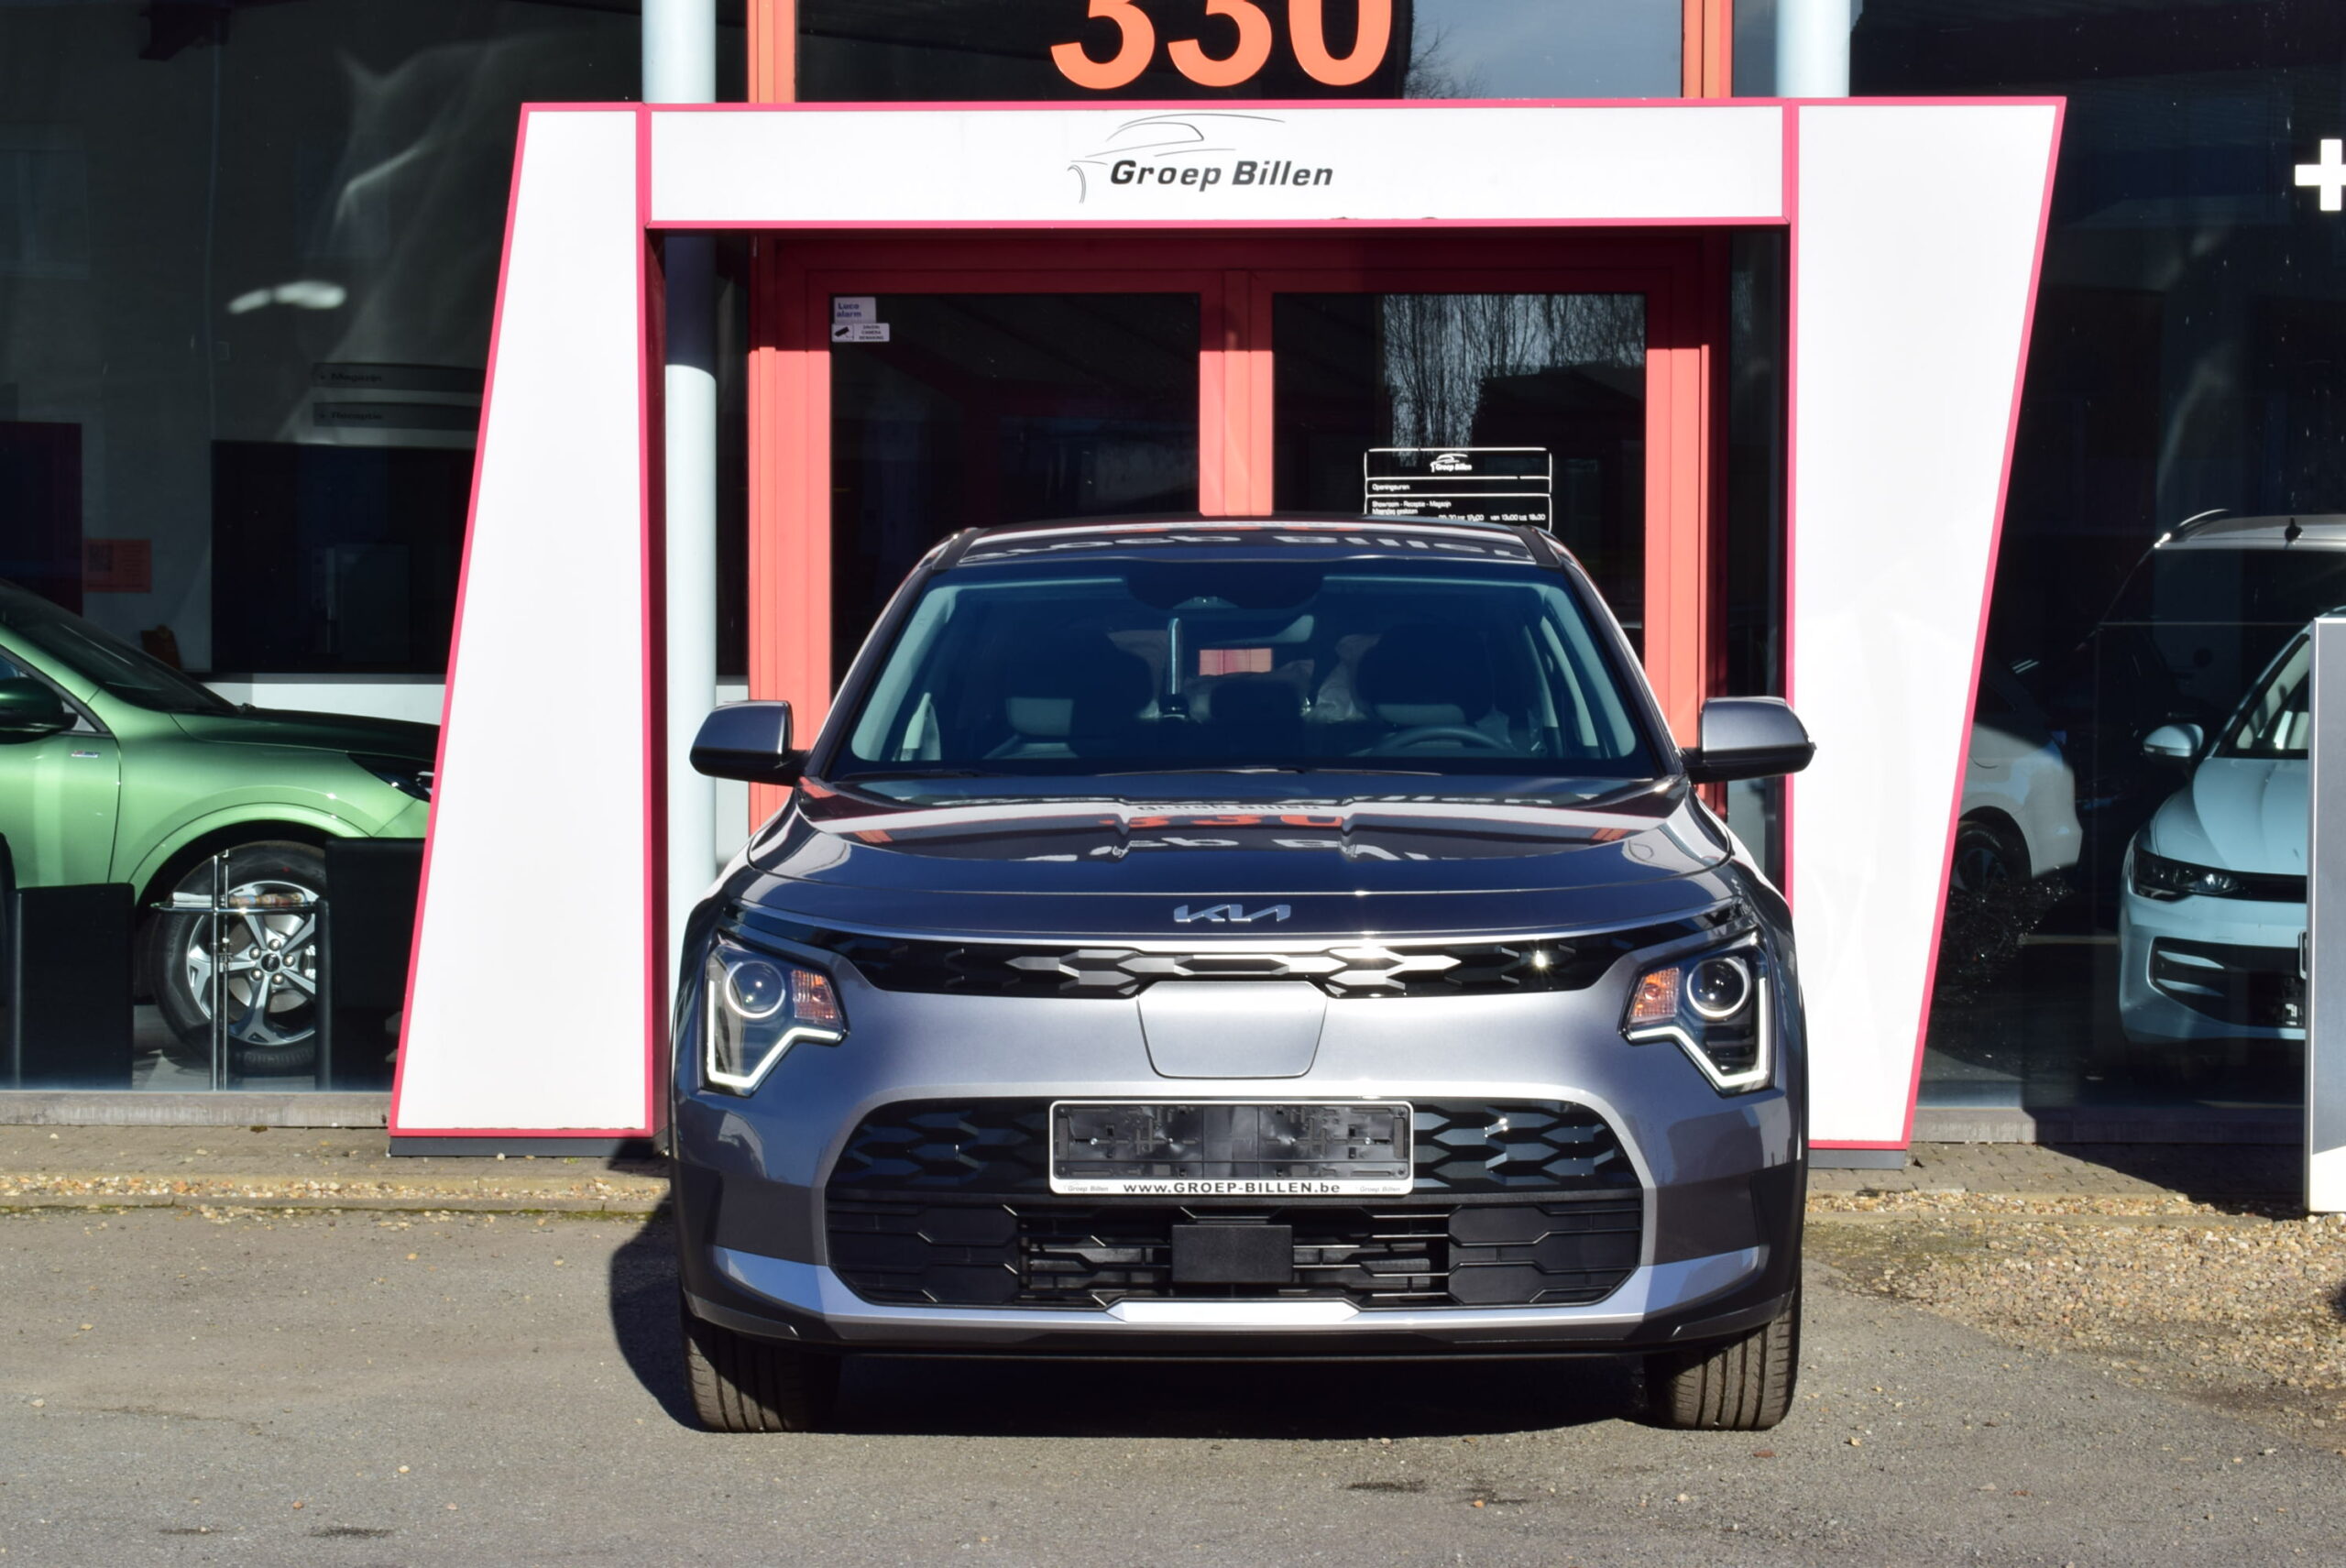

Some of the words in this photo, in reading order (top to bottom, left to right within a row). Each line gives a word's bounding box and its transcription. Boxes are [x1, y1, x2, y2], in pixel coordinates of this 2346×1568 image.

[1110, 159, 1222, 192] Groep
[1232, 159, 1334, 187] Billen
[836, 310, 862, 318] alarm
[331, 373, 382, 383] Magazijn
[1435, 464, 1454, 472] Groep
[1067, 1185, 1088, 1193] Groep
[1123, 1181, 1341, 1194] www.GROEP-BILLEN.be
